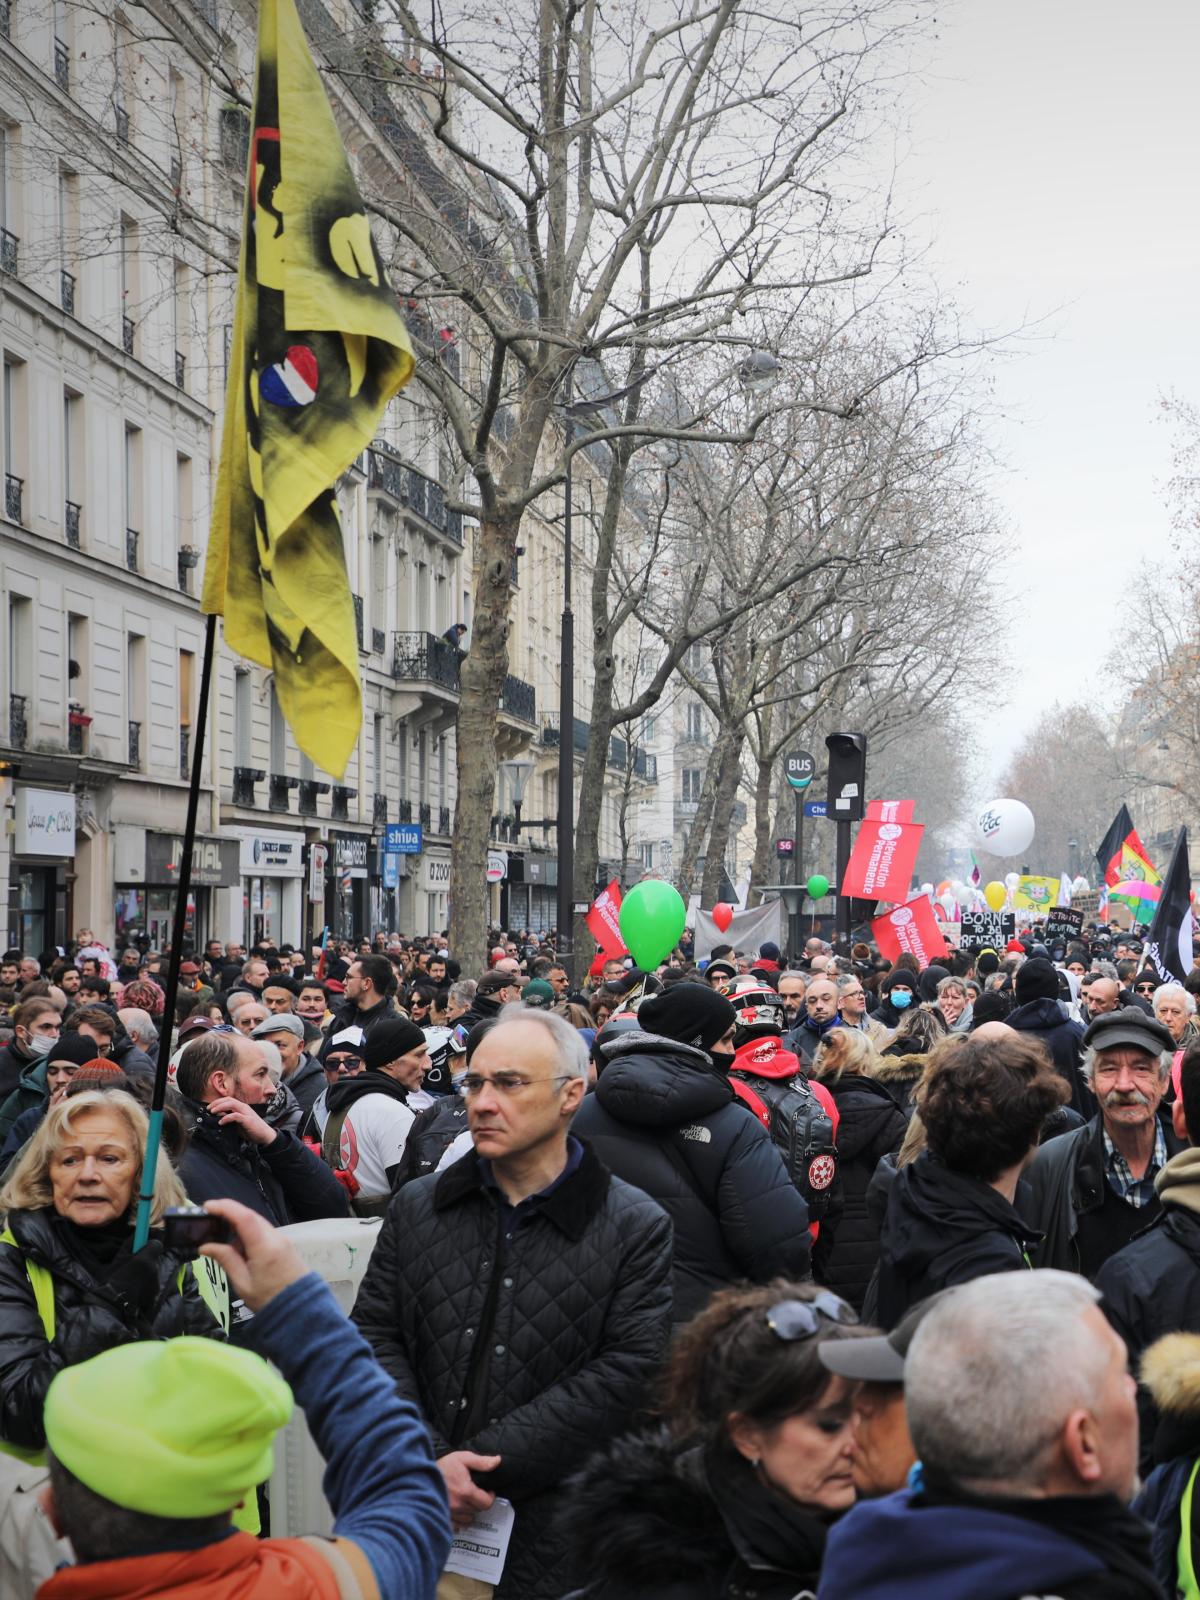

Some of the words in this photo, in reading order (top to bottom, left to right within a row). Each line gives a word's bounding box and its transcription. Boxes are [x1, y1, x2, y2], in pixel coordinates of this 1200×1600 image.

[788, 758, 811, 771] BUS
[811, 805, 827, 814] Che
[983, 816, 1002, 833] CGC
[389, 827, 419, 845] shiva
[779, 841, 792, 850] 56
[172, 840, 222, 870] INTIAL
[863, 839, 886, 894] Permanente
[876, 839, 897, 888] Révolution
[962, 912, 1011, 926] BORNE
[987, 925, 1002, 935] BE
[453, 1540, 477, 1552] MACRO
